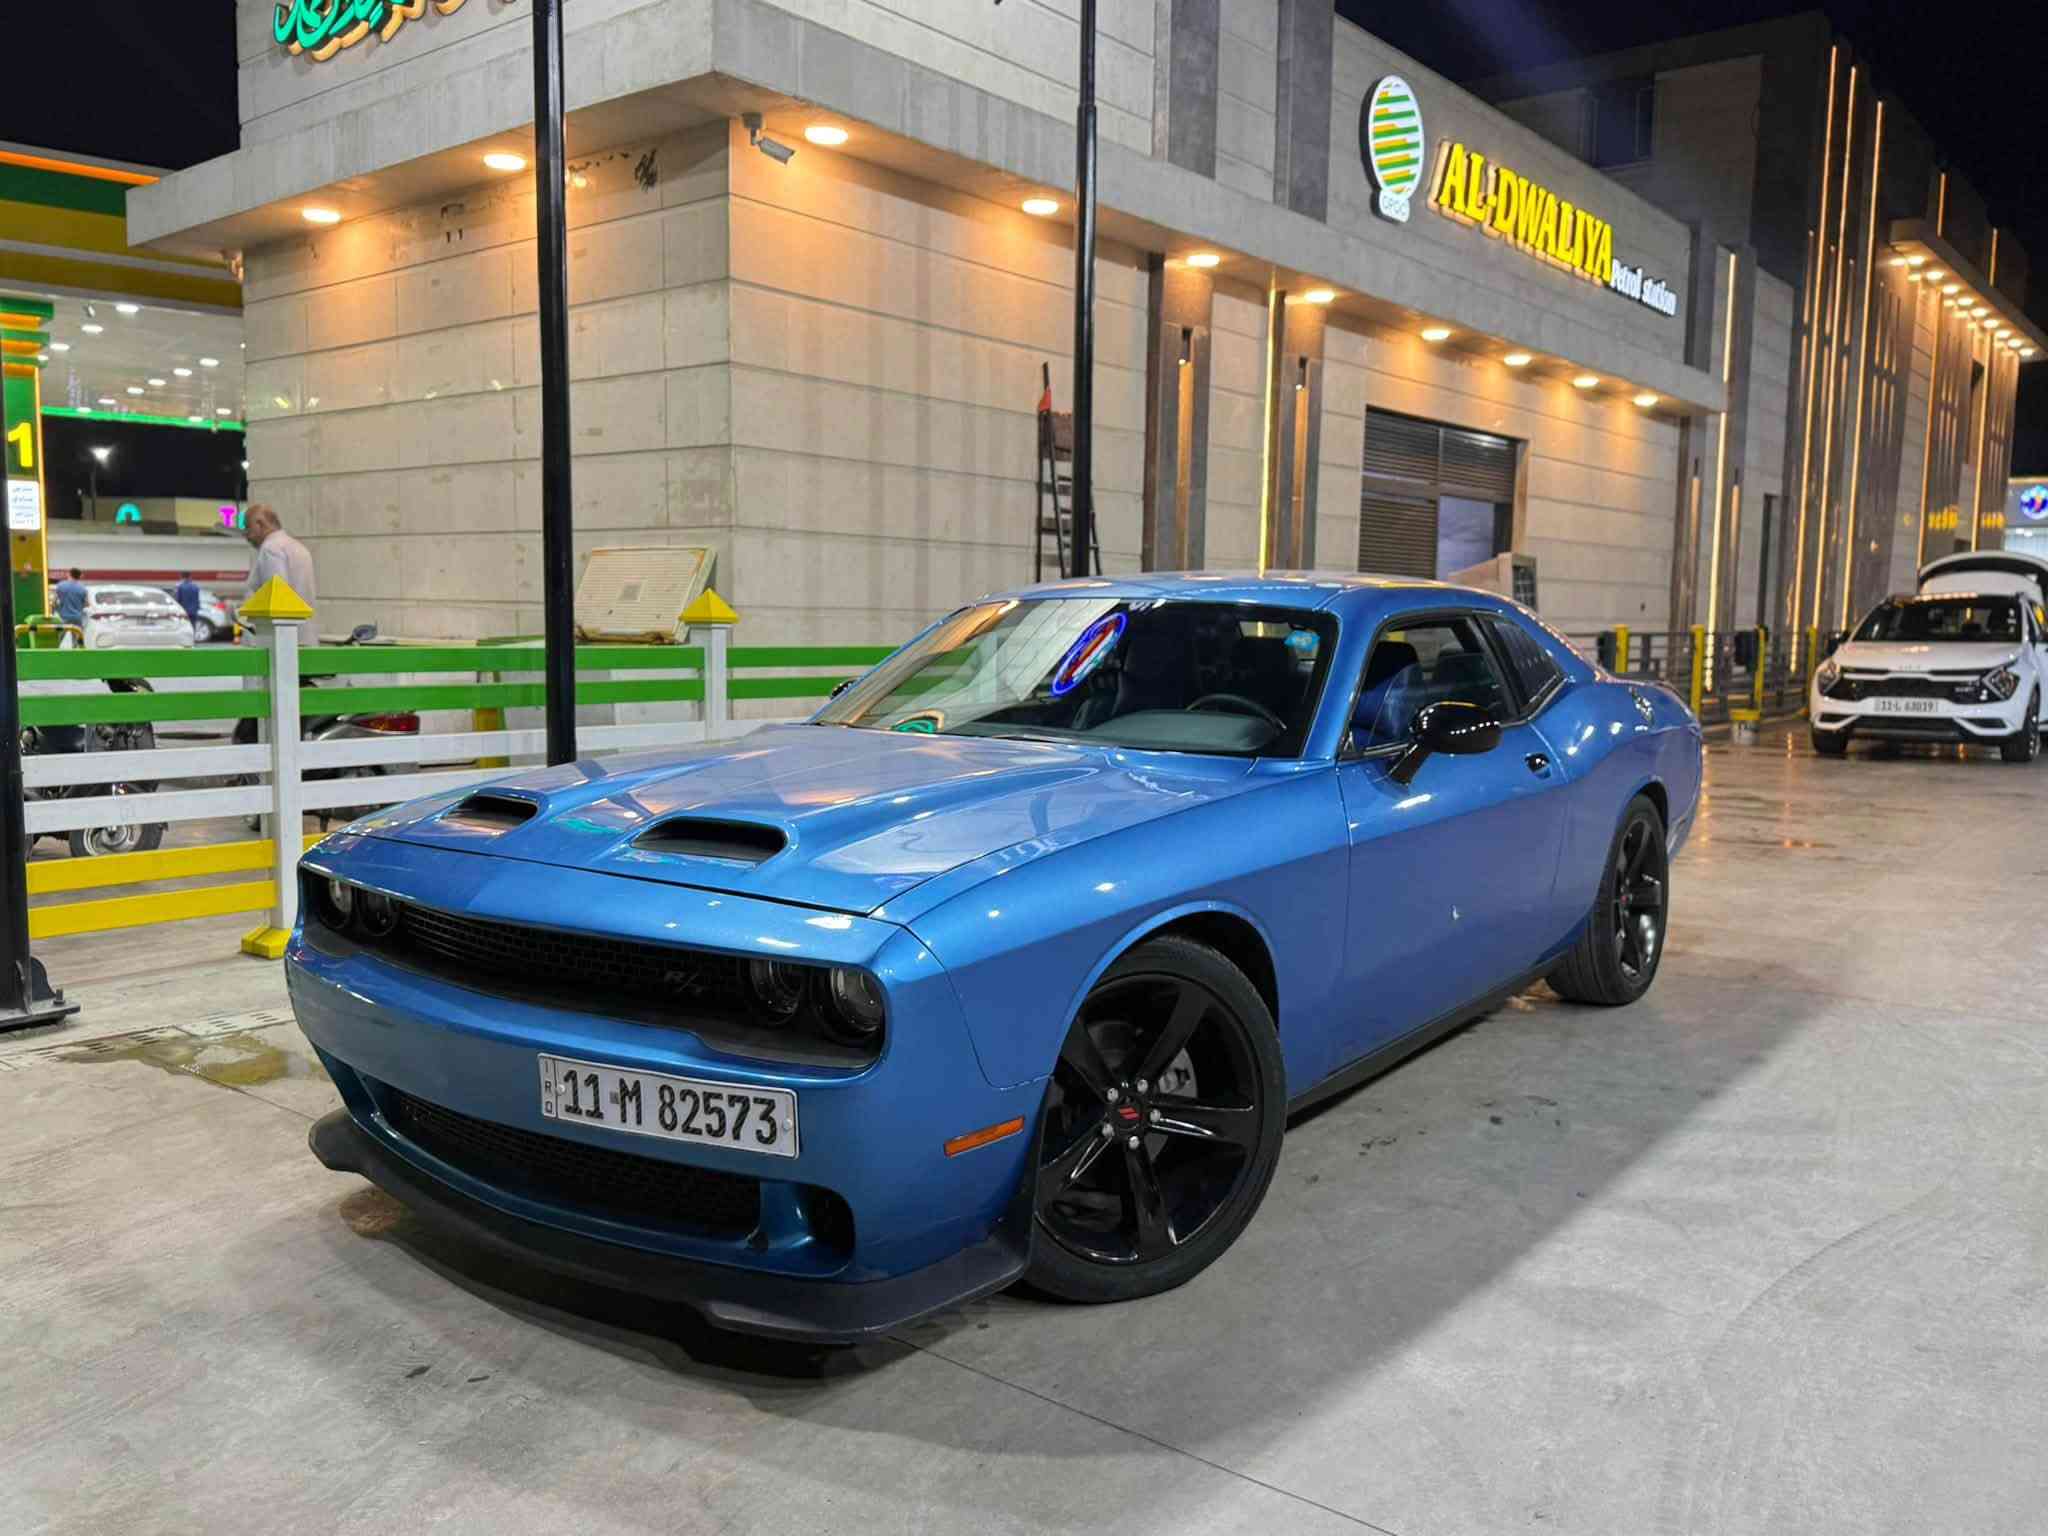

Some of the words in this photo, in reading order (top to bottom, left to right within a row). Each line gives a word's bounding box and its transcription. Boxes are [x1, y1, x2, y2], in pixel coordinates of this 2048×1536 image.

[1439, 142, 1612, 283] AL-DWALIYA
[1609, 257, 1643, 300] Petrol
[1642, 278, 1677, 316] station
[8, 422, 32, 467] 1
[564, 1069, 604, 1120] 11
[619, 1077, 642, 1126] M
[658, 1084, 778, 1146] 82573
